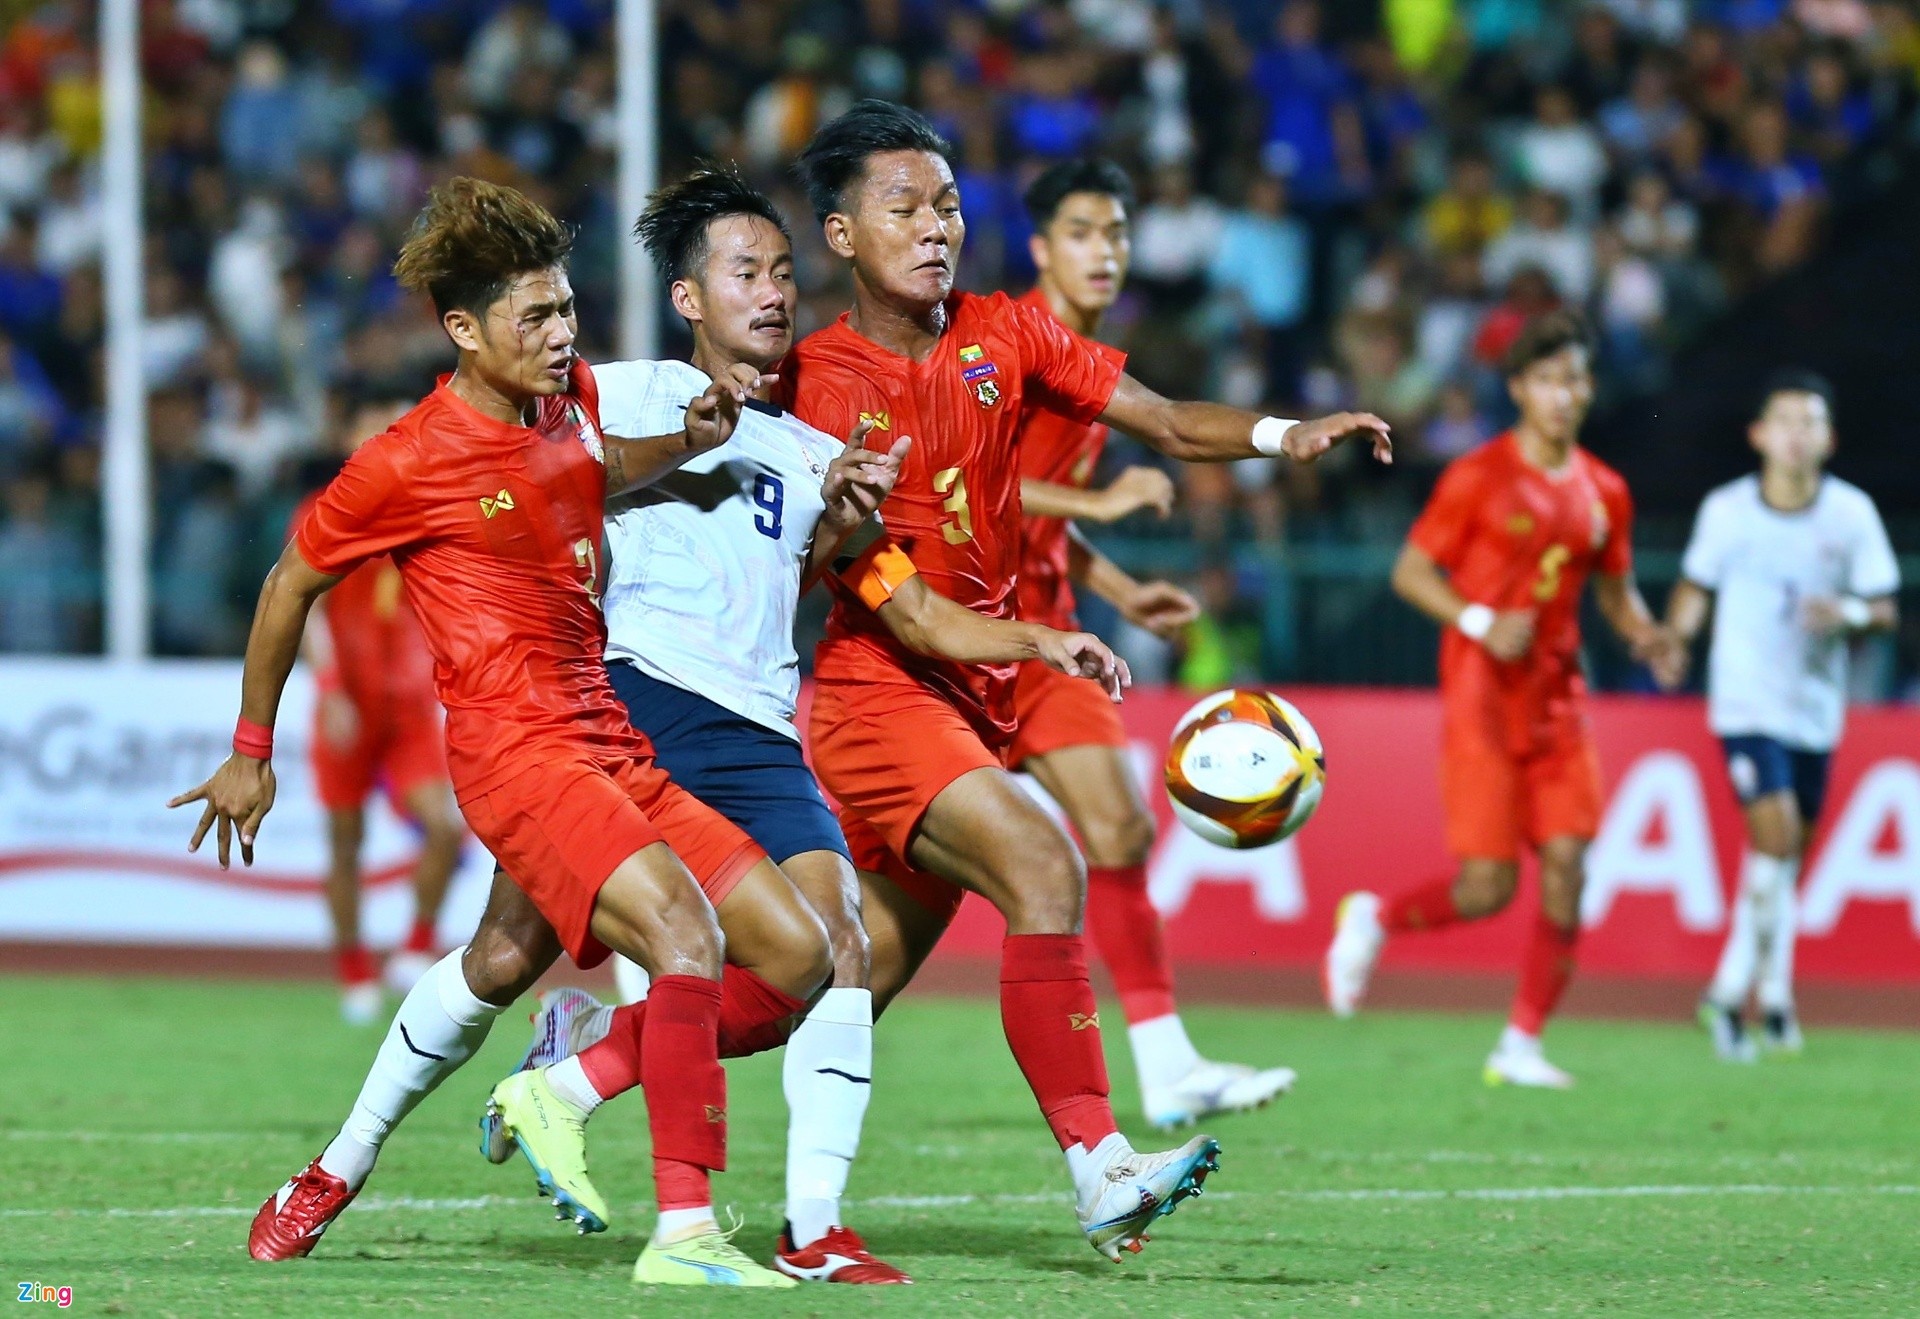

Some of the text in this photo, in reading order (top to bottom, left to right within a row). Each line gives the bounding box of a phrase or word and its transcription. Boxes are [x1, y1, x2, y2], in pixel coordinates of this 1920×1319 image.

[754, 473, 784, 540] 9
[934, 467, 974, 544] 3
[1532, 544, 1574, 601] 5
